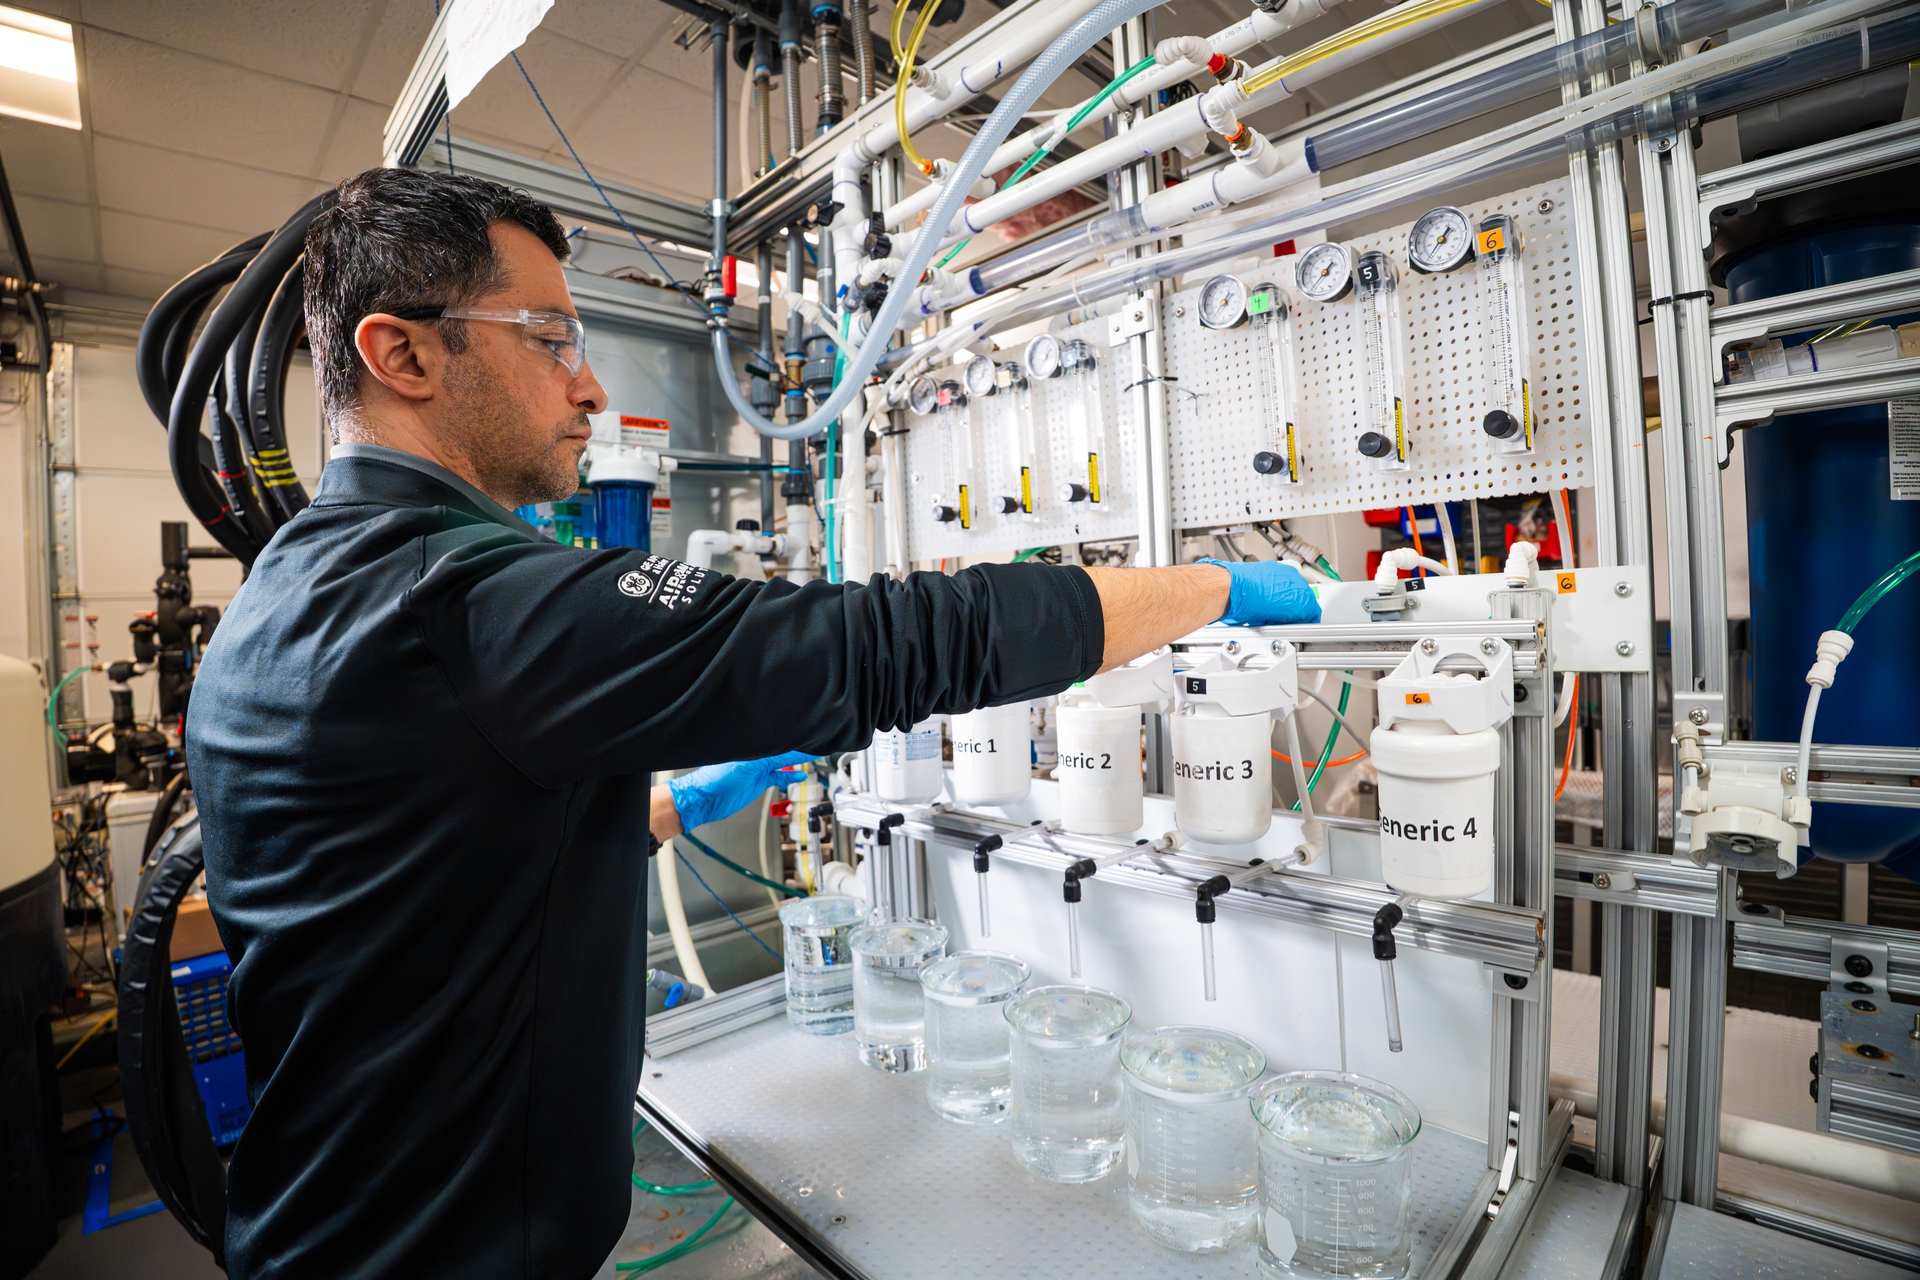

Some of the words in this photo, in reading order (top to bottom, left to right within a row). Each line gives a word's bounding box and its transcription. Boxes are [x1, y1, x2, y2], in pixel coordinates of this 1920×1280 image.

[1486, 232, 1497, 248] 6
[1364, 266, 1372, 280] 5
[1254, 296, 1262, 310] 4
[1066, 354, 1074, 364] 3
[1412, 581, 1418, 590] 5
[1561, 578, 1572, 590] 6
[1192, 681, 1199, 691] 5
[1412, 694, 1422, 704] 6
[987, 739, 997, 752] 1
[1101, 753, 1112, 769] 2
[1174, 760, 1234, 780] eneric
[1241, 760, 1253, 779] 3
[1463, 817, 1477, 839] 4
